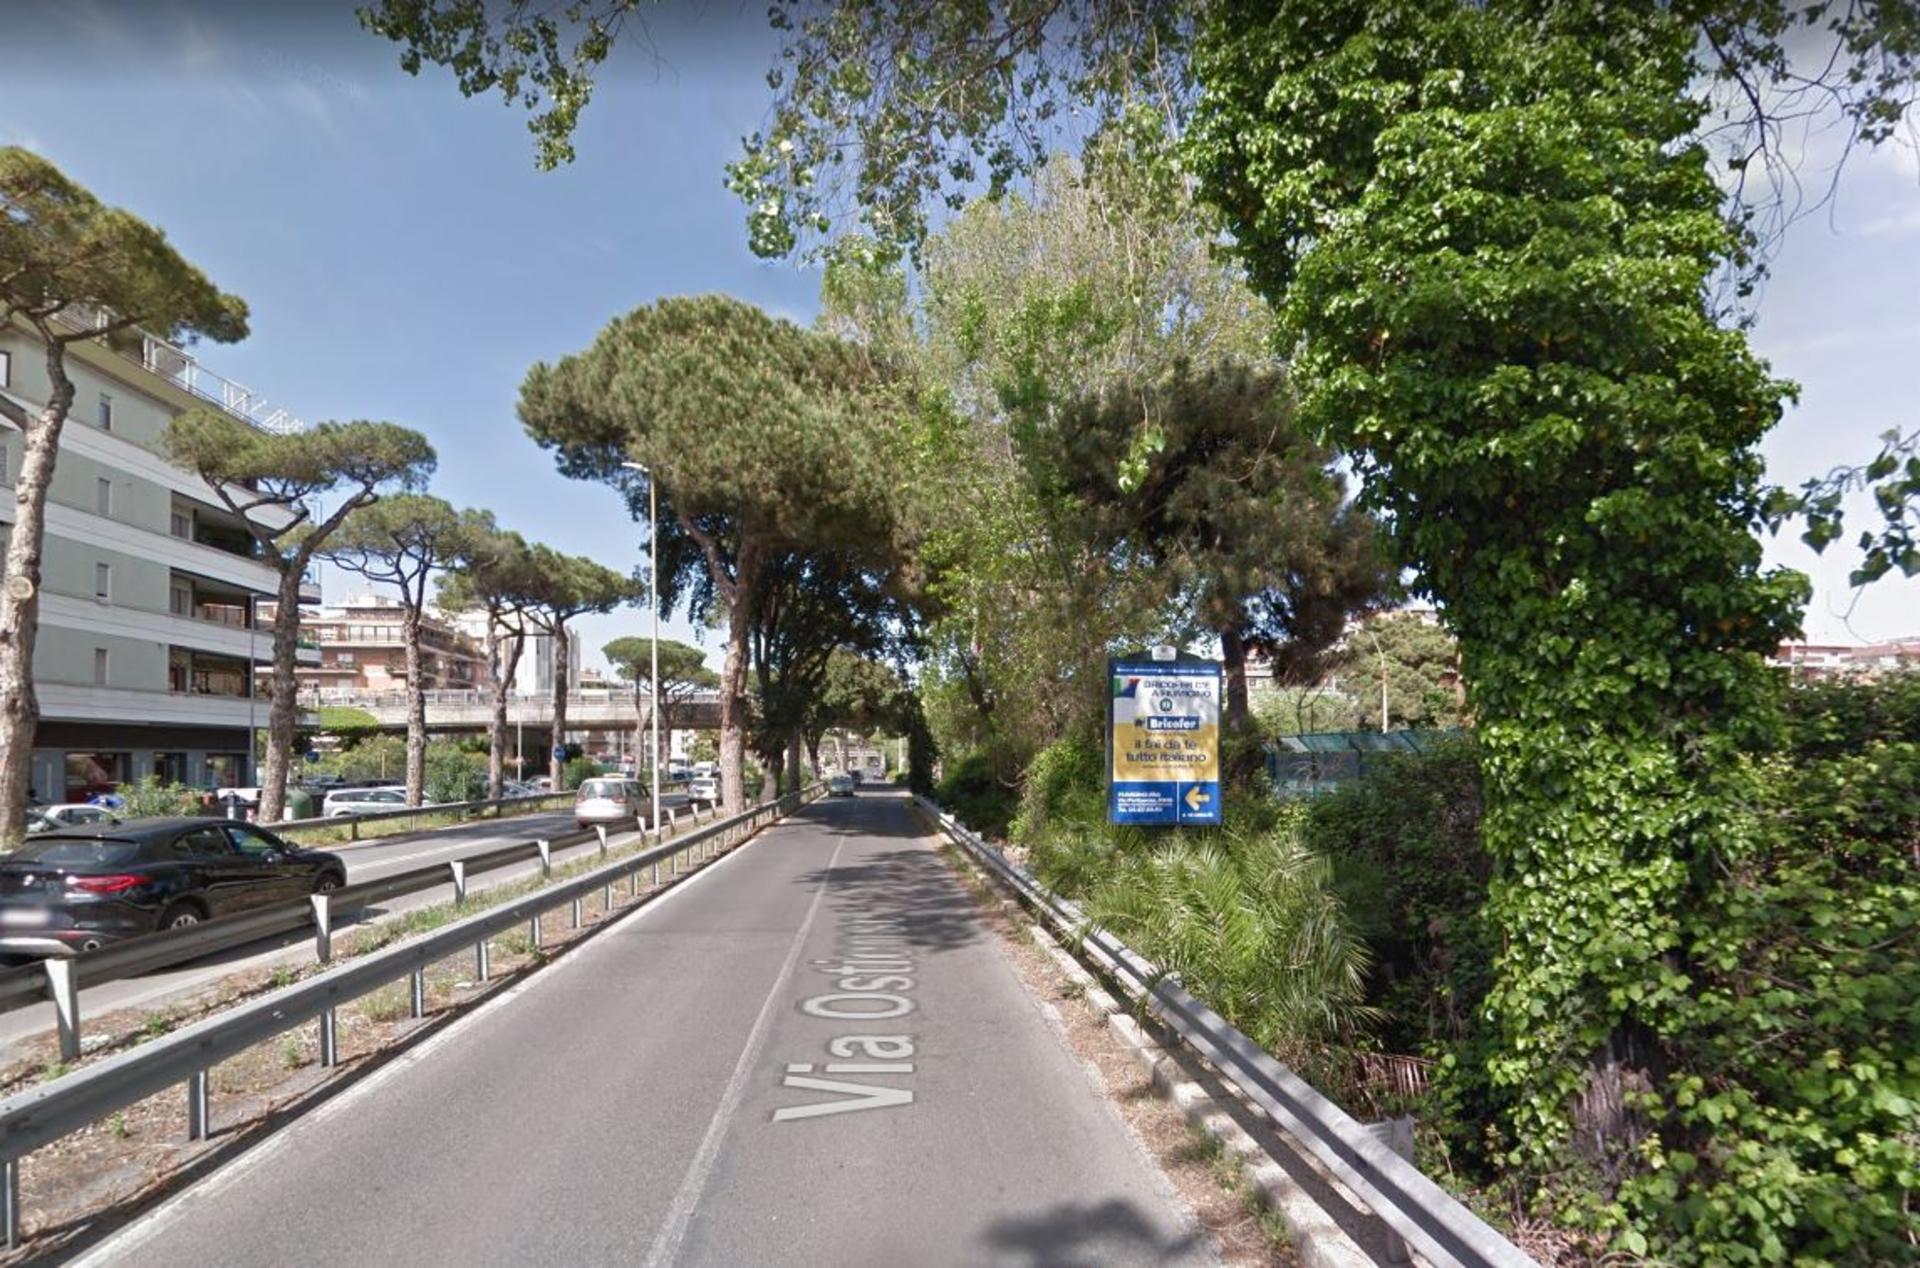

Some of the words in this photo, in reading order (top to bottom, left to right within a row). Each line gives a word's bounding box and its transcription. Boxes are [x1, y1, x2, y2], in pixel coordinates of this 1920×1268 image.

[1150, 718, 1196, 729] Bricofer
[1164, 739, 1181, 749] da
[1185, 739, 1197, 749] te
[1126, 752, 1157, 762] tutto
[1160, 752, 1206, 762] italiano
